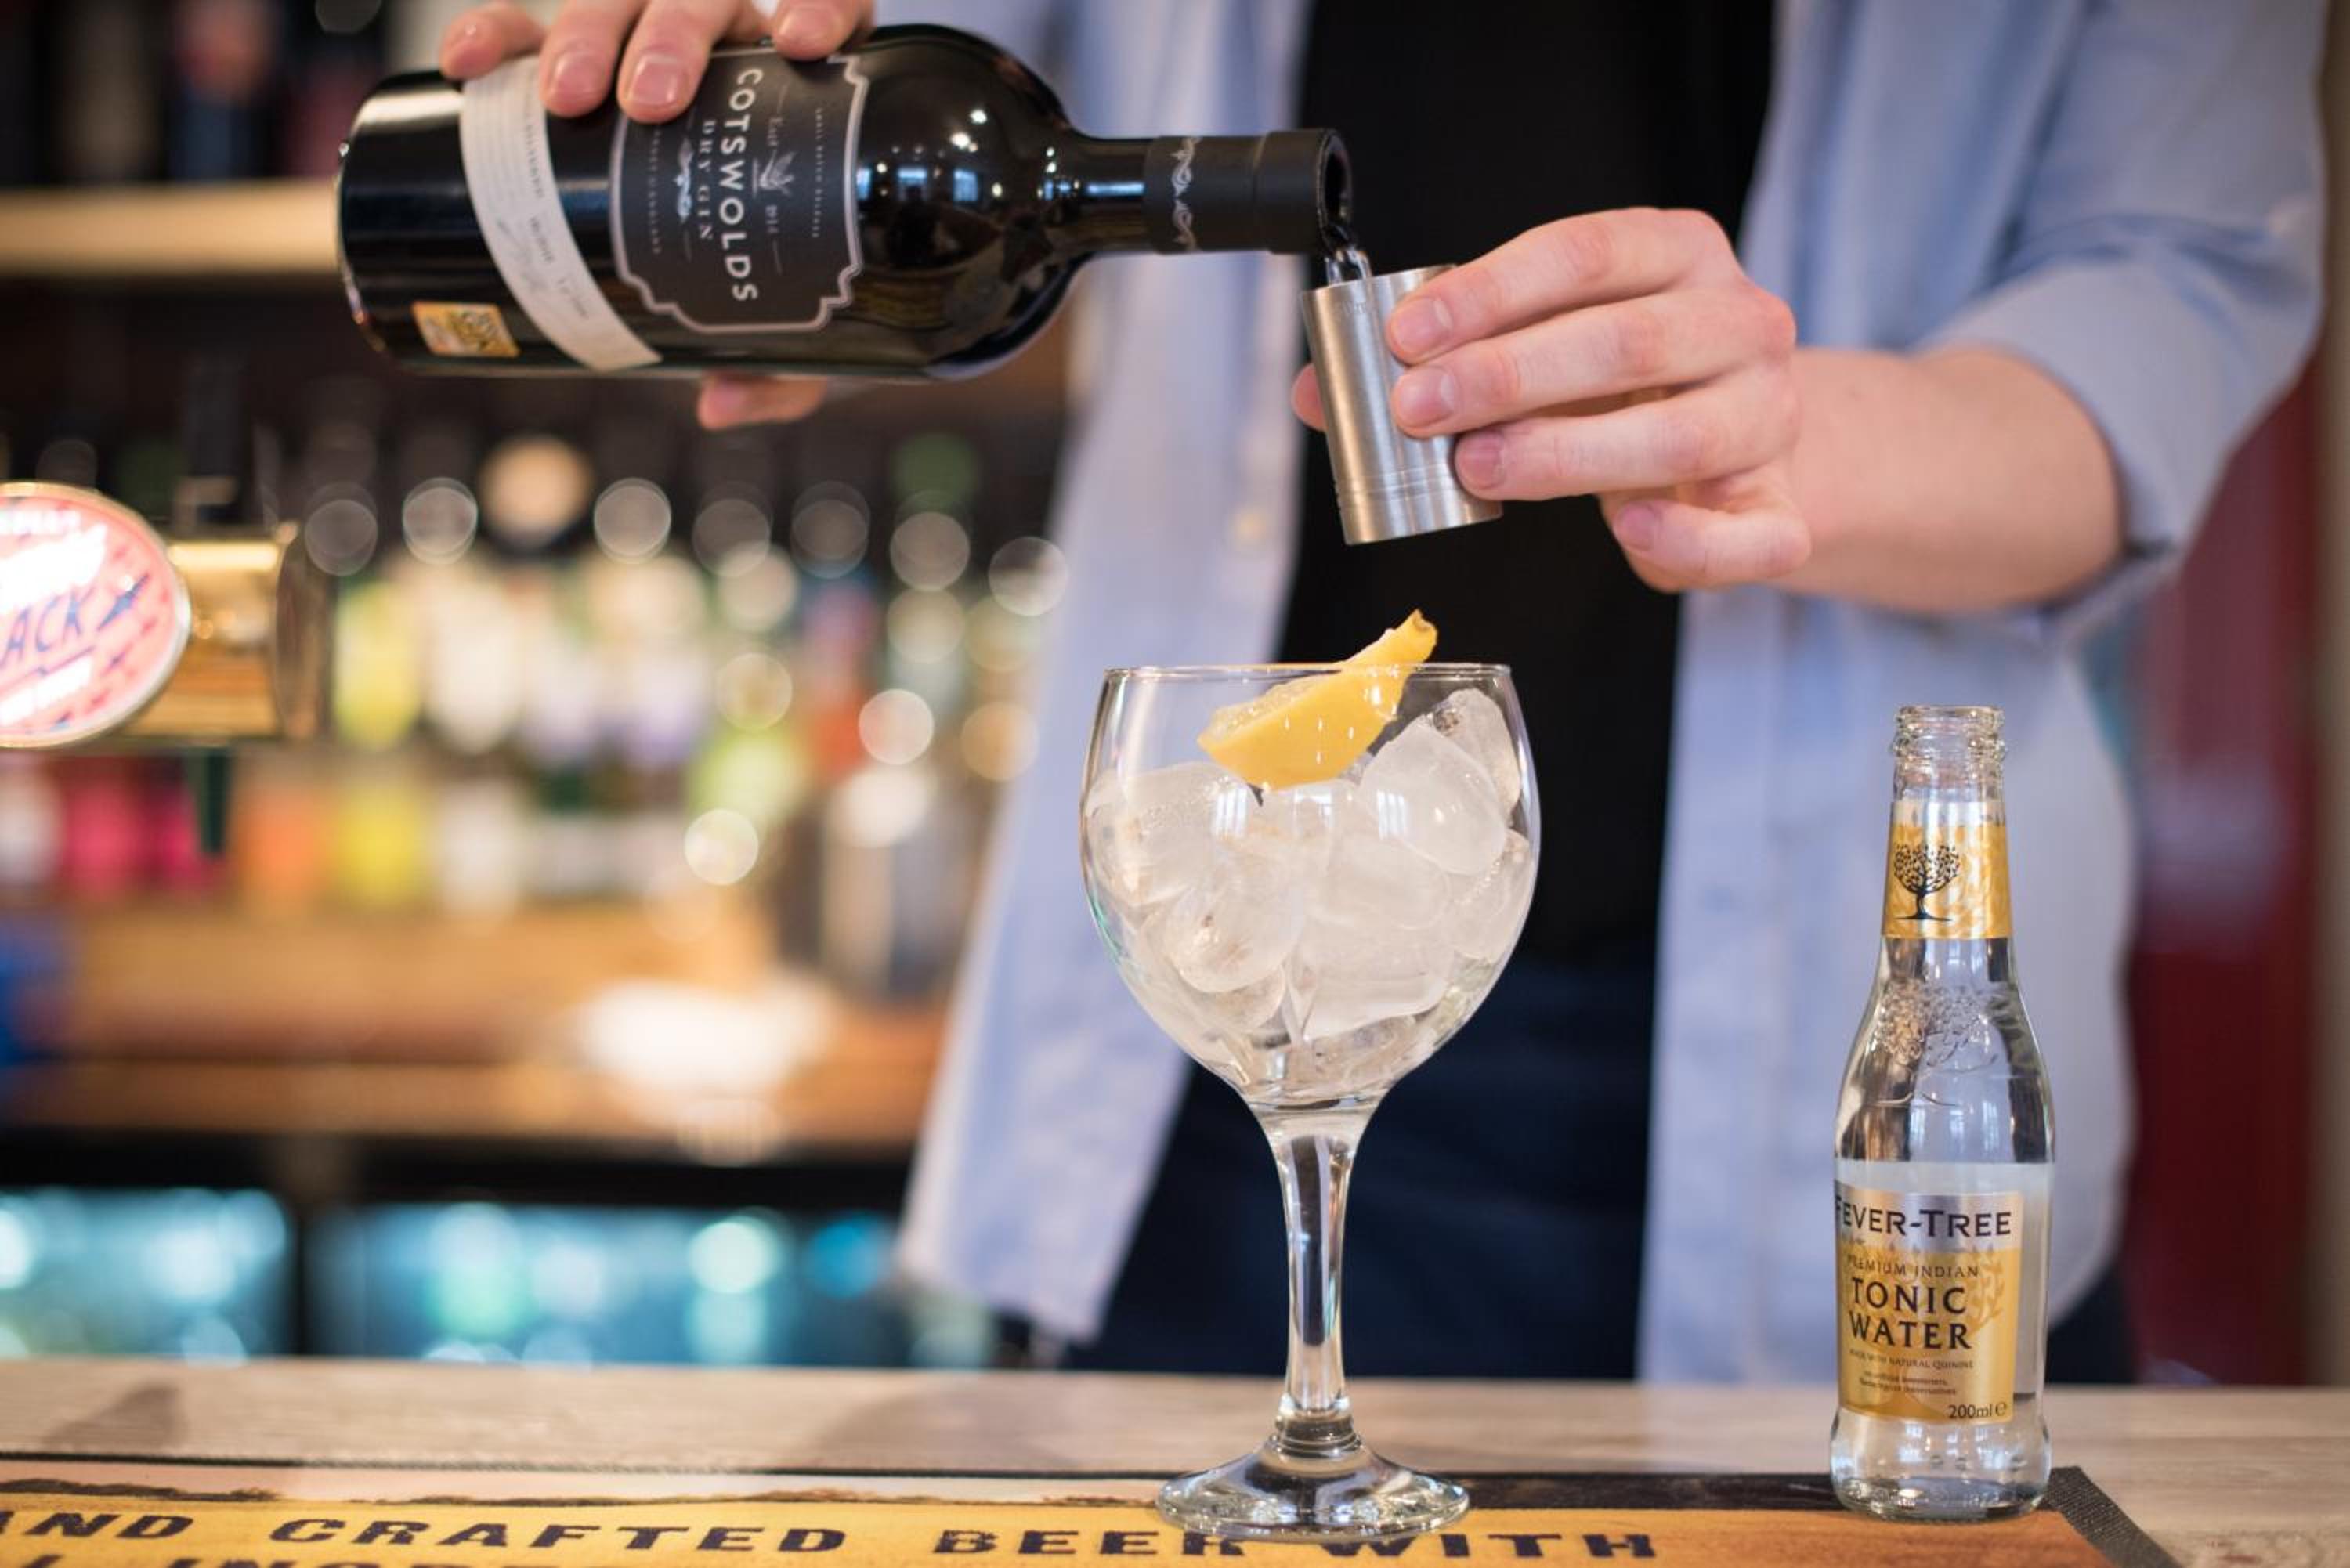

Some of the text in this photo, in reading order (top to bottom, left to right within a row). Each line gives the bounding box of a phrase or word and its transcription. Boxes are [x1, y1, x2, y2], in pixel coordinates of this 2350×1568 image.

[697, 120, 716, 240] DRY GIN
[718, 68, 764, 302] COTSWOLDS
[1835, 1194, 2012, 1238] FEVER-TREE
[1846, 1253, 1979, 1278] PREMIUM INDIAN
[1850, 1277, 1967, 1315] TONIC
[1849, 1311, 1972, 1350] WATER
[1948, 1404, 1992, 1419] 200ml
[269, 1518, 847, 1552] CRAFTED
[932, 1530, 1245, 1557] BEER
